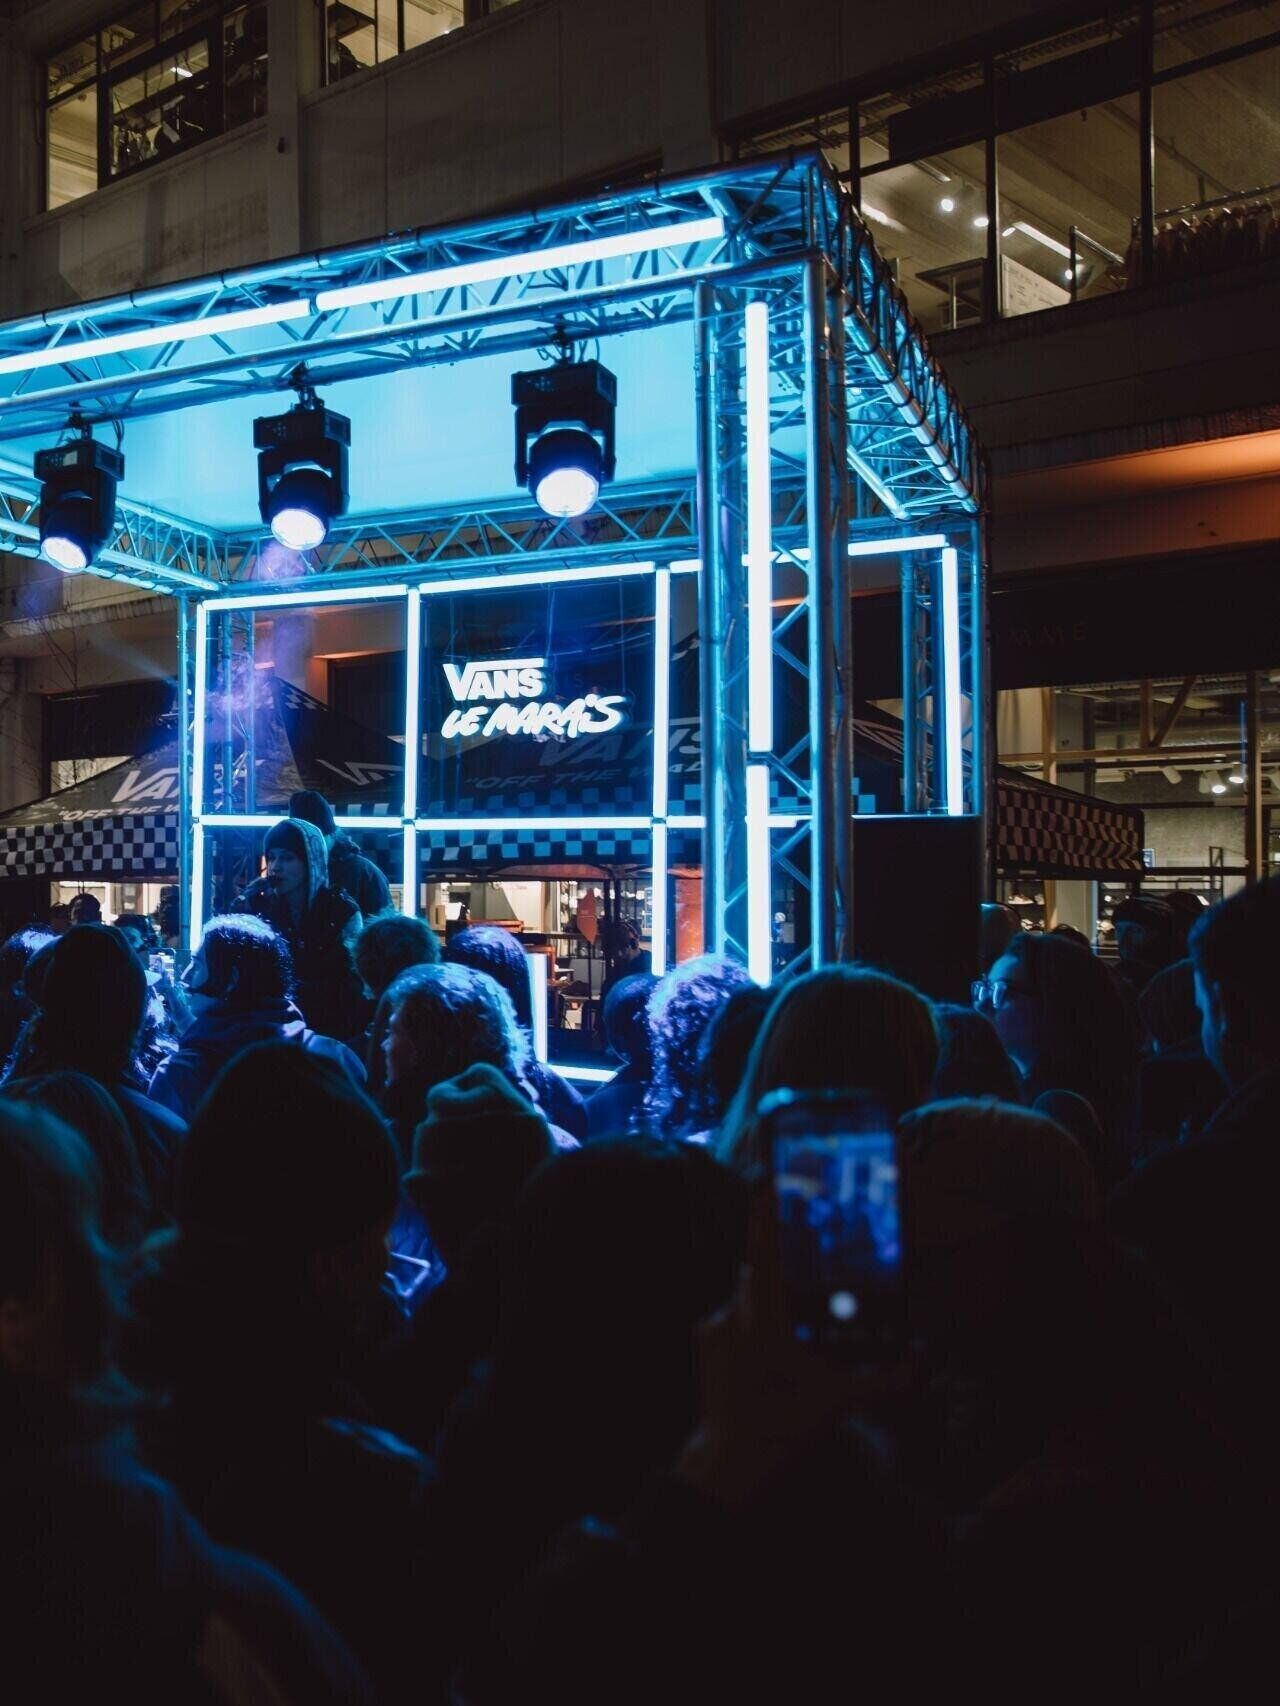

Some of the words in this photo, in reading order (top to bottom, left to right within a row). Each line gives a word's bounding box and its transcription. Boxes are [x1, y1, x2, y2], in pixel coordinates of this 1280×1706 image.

[442, 658, 546, 702] VANS
[441, 705, 490, 739] LE
[552, 768, 622, 784] THE
